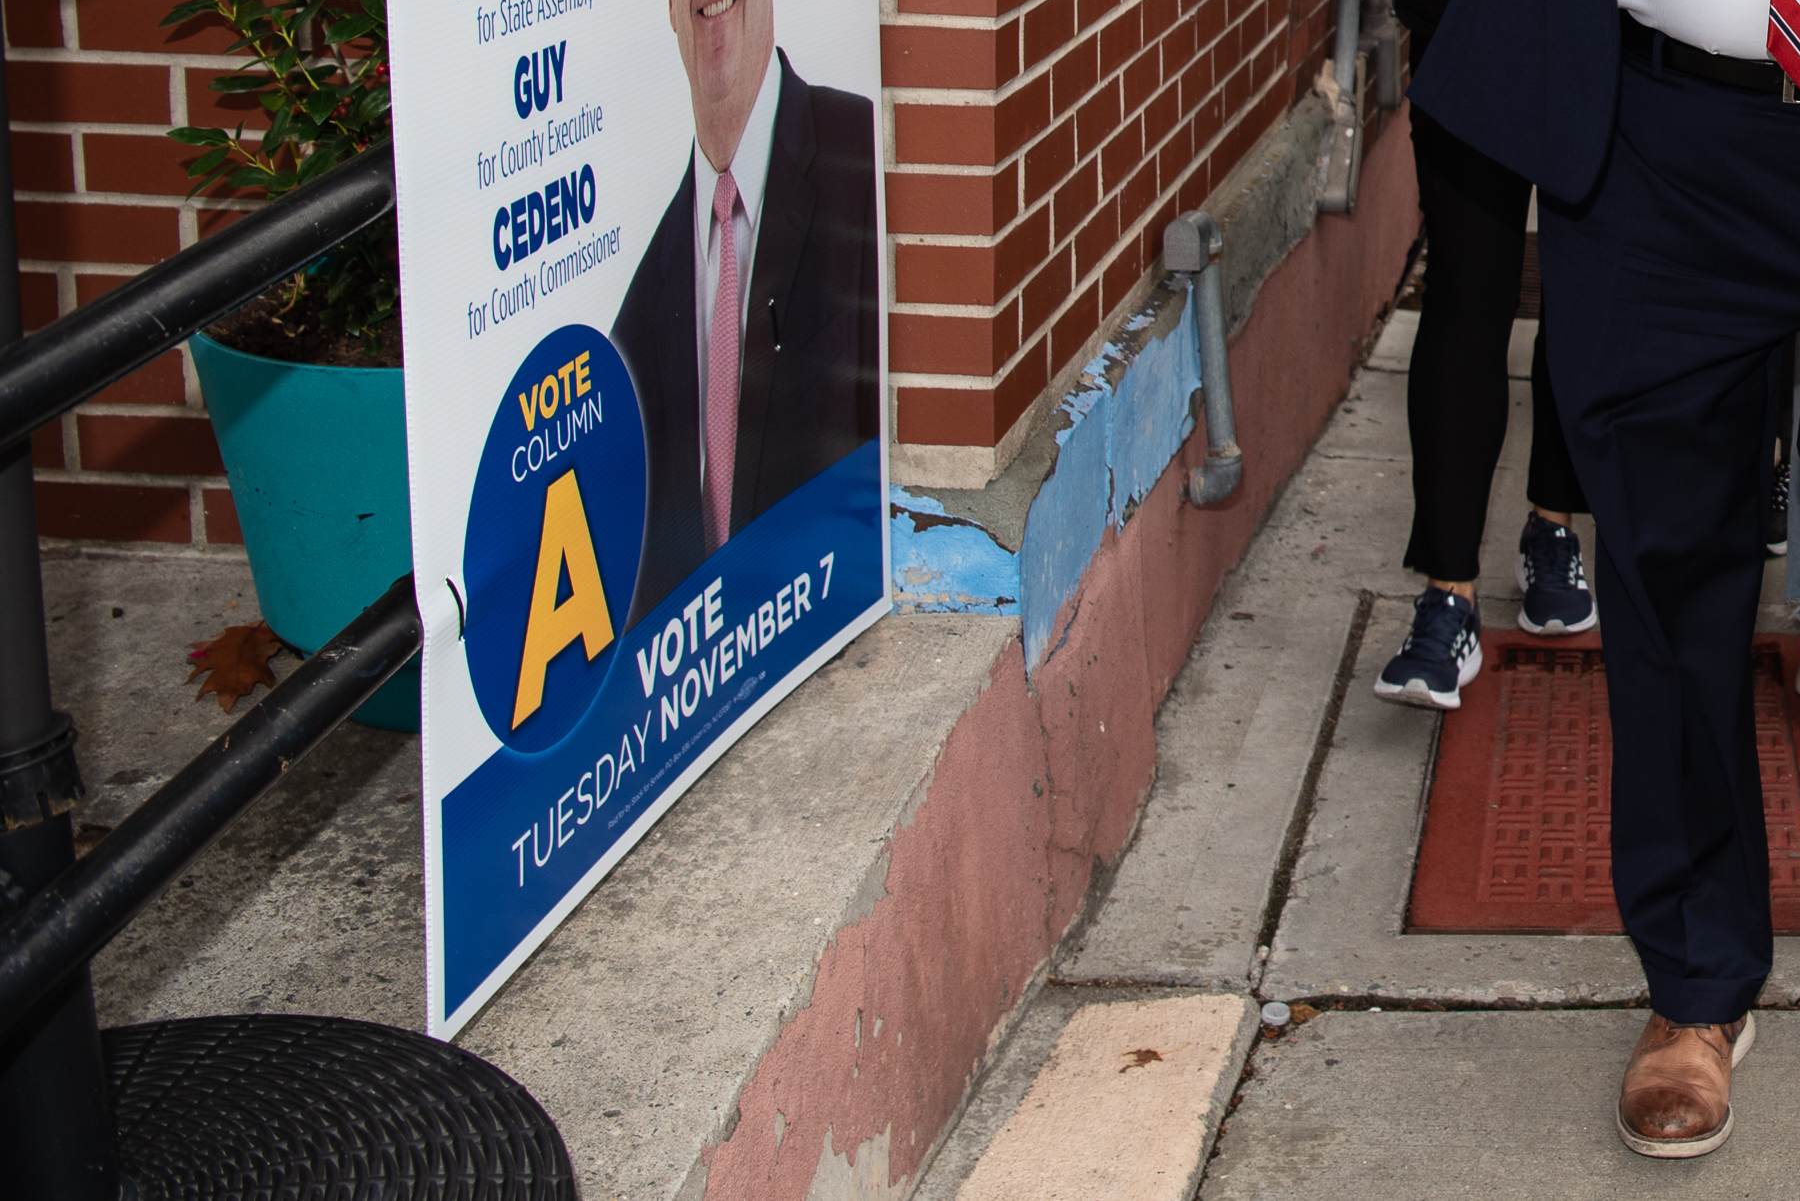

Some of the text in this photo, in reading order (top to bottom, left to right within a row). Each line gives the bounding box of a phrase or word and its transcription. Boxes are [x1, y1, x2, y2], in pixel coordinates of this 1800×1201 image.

[476, 5, 497, 45] for
[513, 40, 567, 120] GUY
[476, 103, 604, 190] for County Executive
[492, 163, 597, 272] CEDENO
[467, 225, 622, 340] for County Commissioner
[511, 391, 603, 483] COLUMN
[518, 350, 592, 432] VOTE
[511, 469, 615, 731] A
[636, 576, 725, 699] VOTE
[511, 552, 834, 887] TUESDAY NOVEMBER 7
